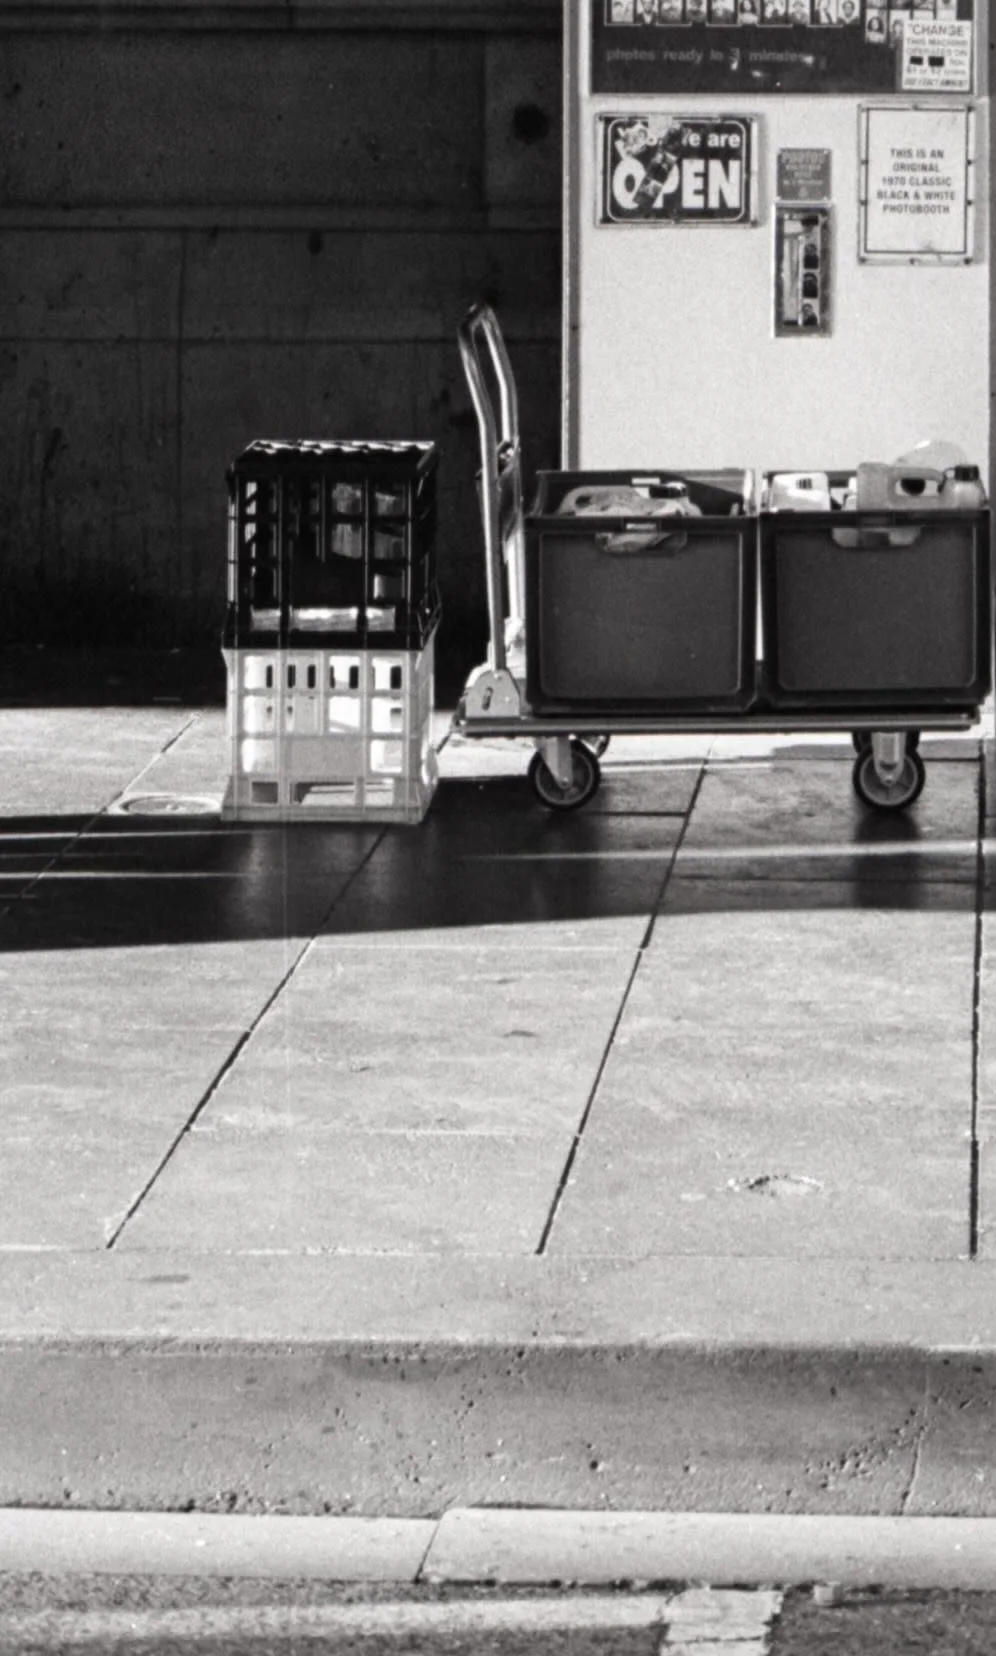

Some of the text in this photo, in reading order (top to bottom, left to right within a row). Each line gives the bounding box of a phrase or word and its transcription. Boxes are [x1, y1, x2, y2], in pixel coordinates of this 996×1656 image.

[664, 49, 703, 65] ready
[708, 132, 741, 148] are
[891, 149, 944, 159] THIS IS AN
[893, 162, 940, 172] ORIGINAL
[612, 157, 741, 210] OPEN
[909, 176, 952, 187] CLASSIC
[877, 190, 909, 200] BLACK
[925, 191, 956, 201] WHITE
[883, 204, 950, 214] PHOTOBOOTH
